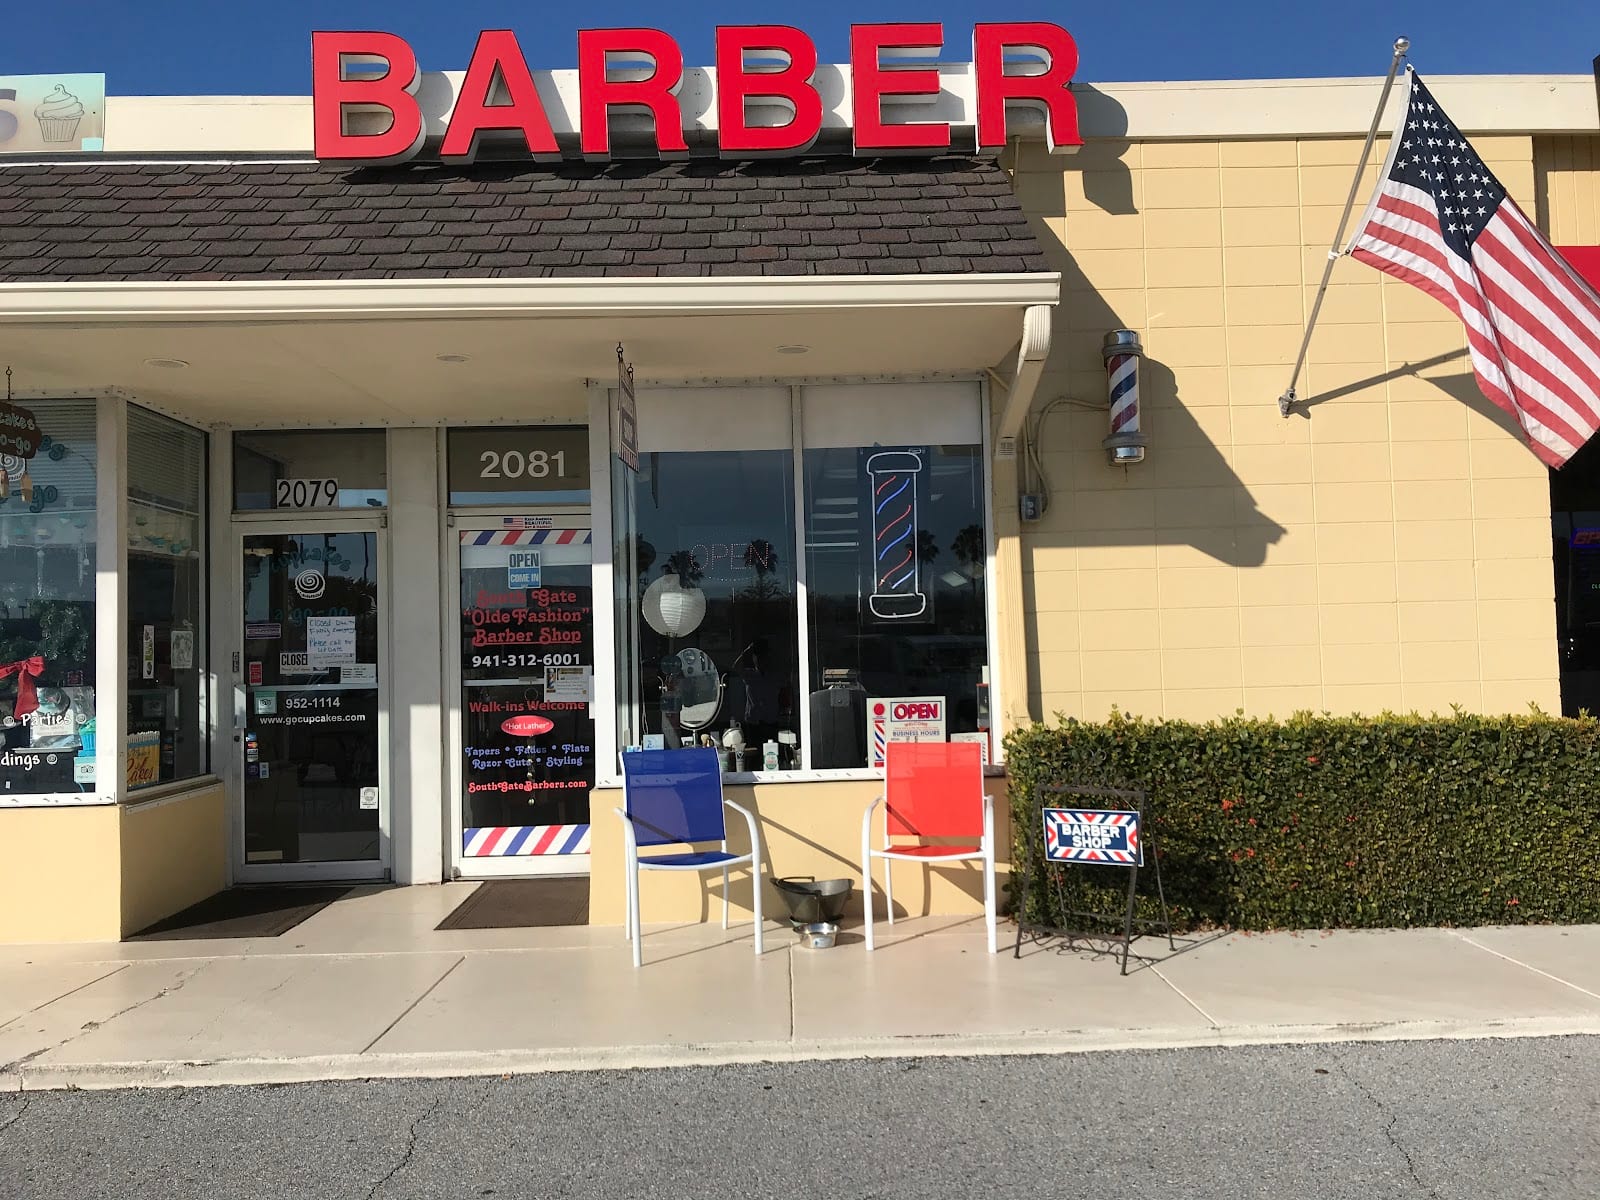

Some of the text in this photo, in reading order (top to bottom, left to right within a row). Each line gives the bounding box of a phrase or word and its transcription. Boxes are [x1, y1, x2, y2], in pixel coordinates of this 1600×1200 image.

[312, 22, 1085, 161] BARBER
[480, 450, 565, 479] 2081
[277, 479, 338, 508] 2079
[509, 553, 539, 567] OPEN
[689, 543, 769, 570] OPEN
[511, 573, 539, 583] COME IN
[477, 589, 578, 608] South Gate
[471, 627, 583, 647] Barber Shop
[472, 653, 581, 667] 941-312-6001
[285, 696, 341, 709] 952-1114
[469, 699, 585, 713] Walk-ins Welcome
[893, 703, 939, 720] OPEN
[20, 713, 72, 727] Parties
[259, 713, 366, 726] www.gocupcakes.com
[465, 743, 590, 757] Tapers Fades Flats
[472, 756, 583, 769] Razor Cuts Styling
[468, 780, 588, 793] SouthGateBarbers.com
[1061, 823, 1121, 839] BARBER
[1072, 835, 1112, 849] SHOP
